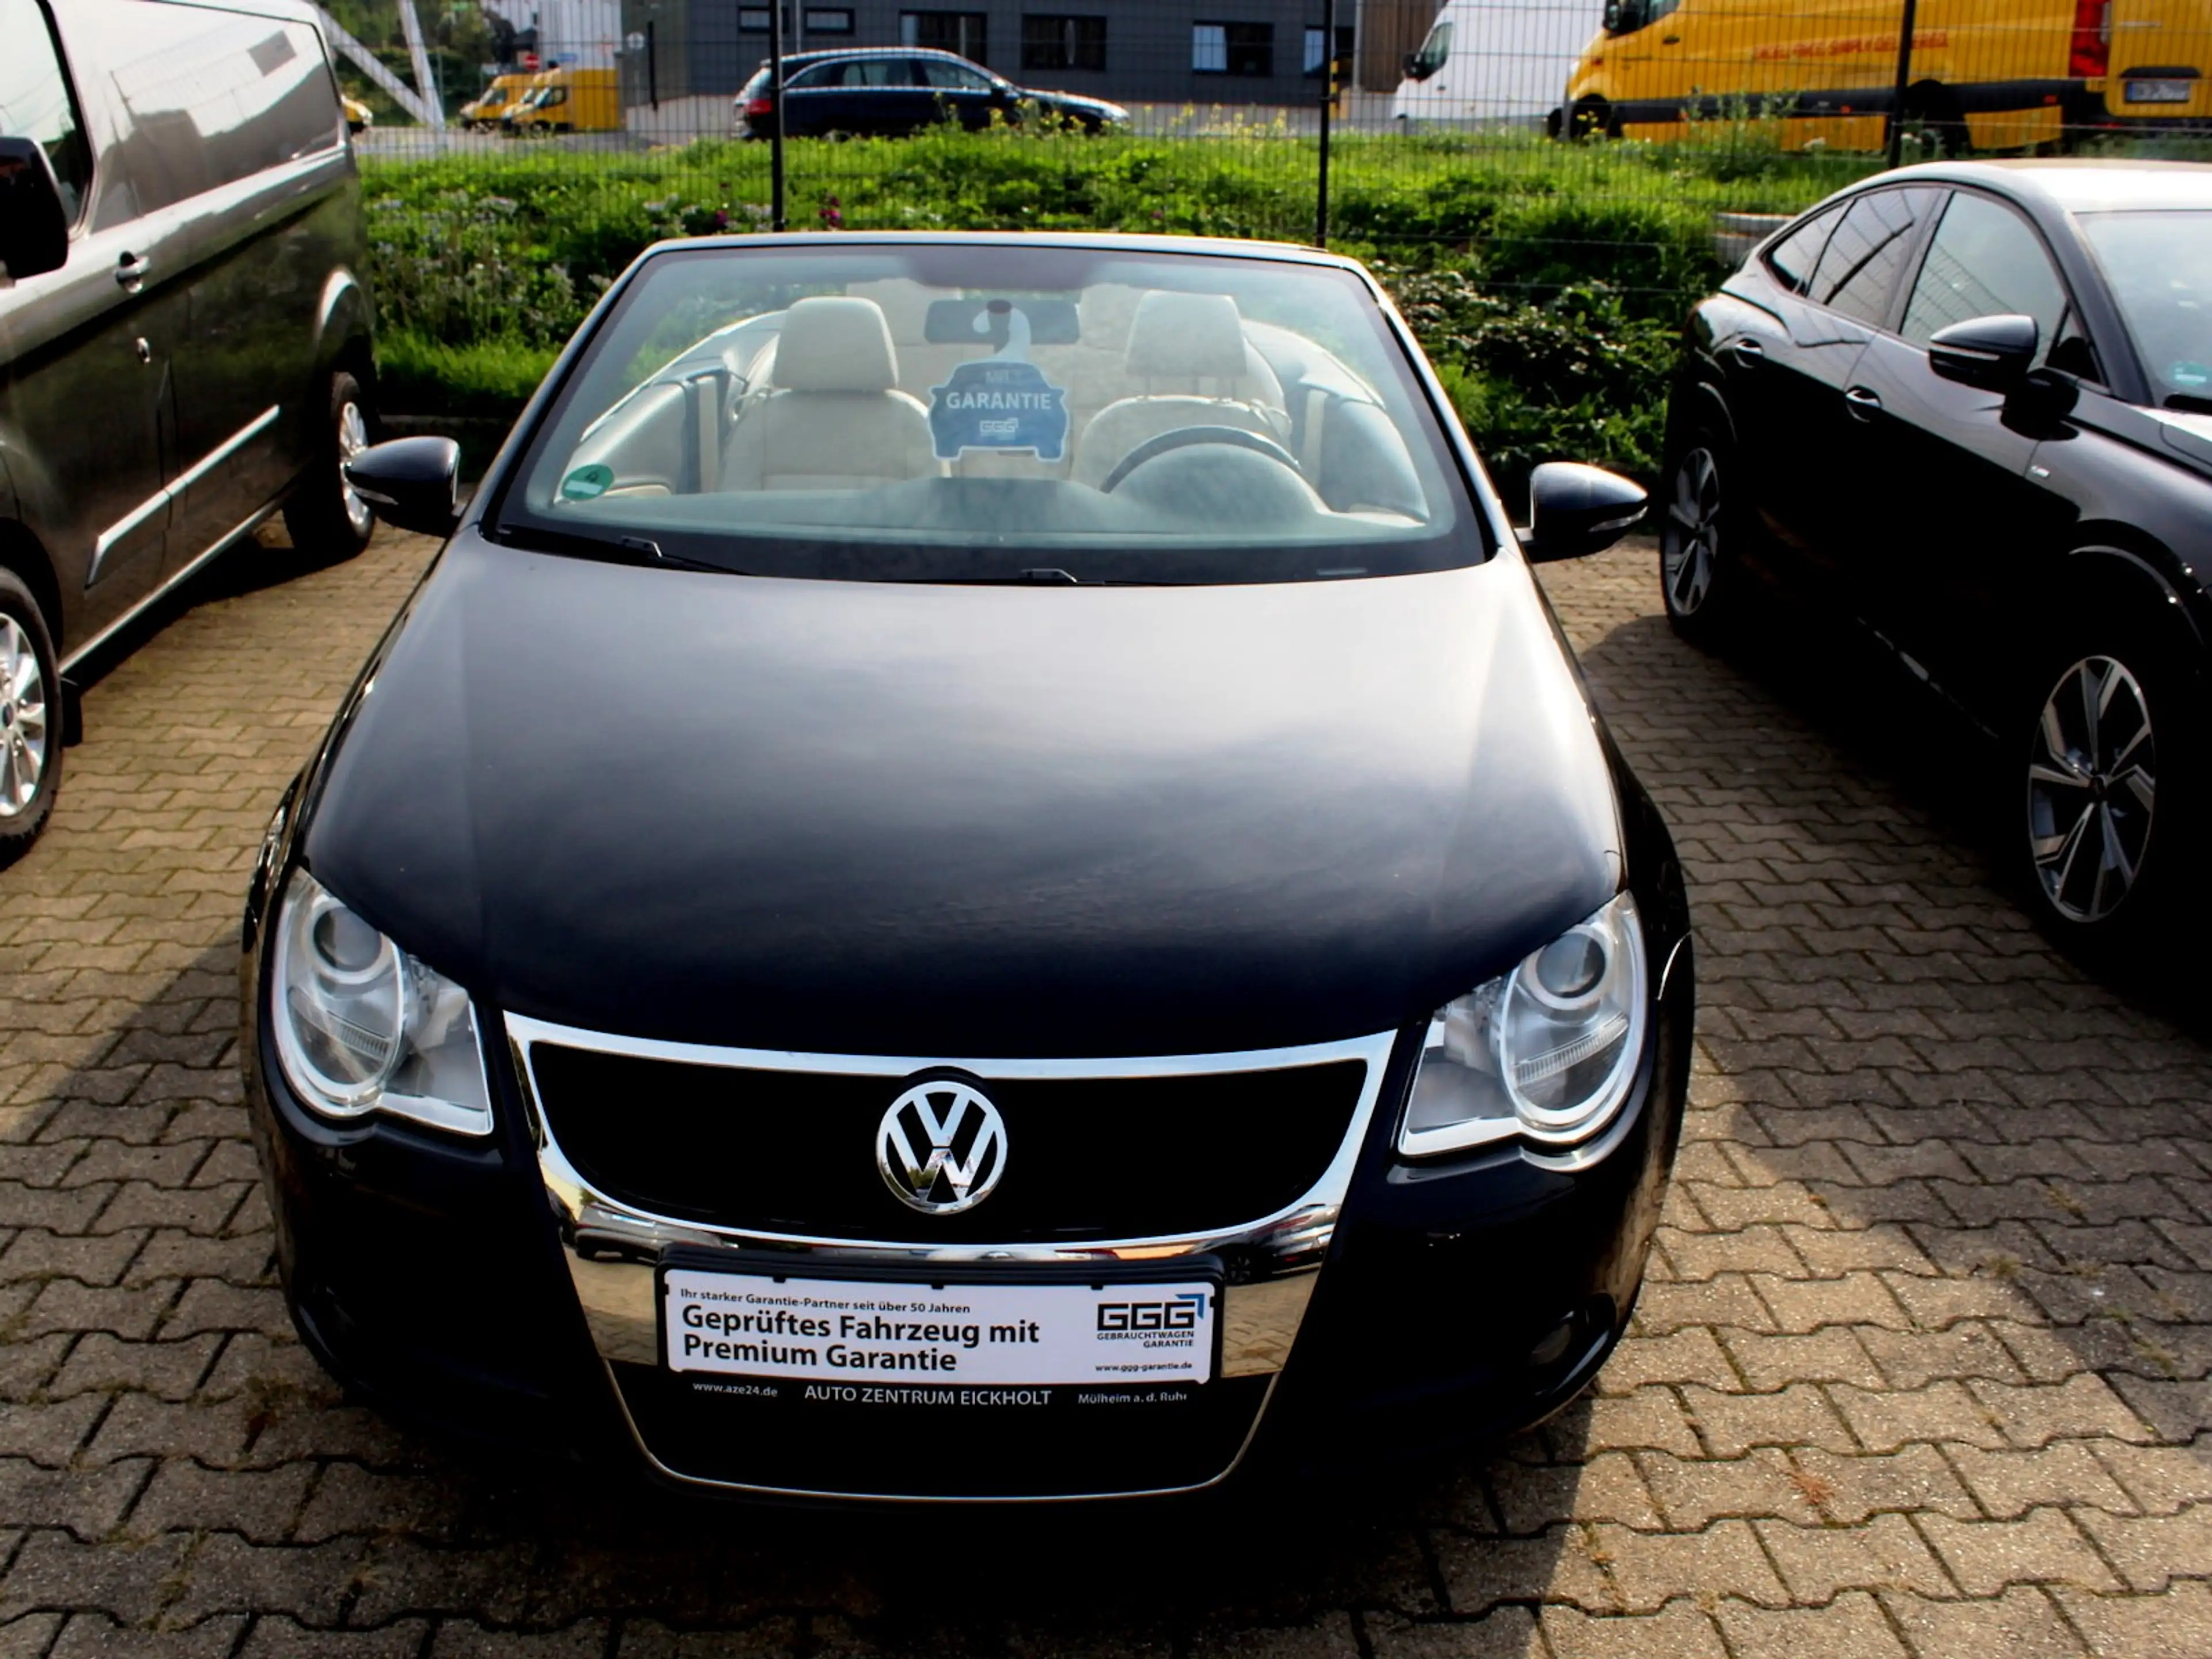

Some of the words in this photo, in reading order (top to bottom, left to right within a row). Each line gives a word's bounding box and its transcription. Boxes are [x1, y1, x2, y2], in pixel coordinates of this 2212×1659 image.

[946, 392, 1051, 410] GARANTIE
[681, 1288, 698, 1298] Ihr
[700, 1291, 742, 1302] starker
[745, 1294, 849, 1309] Garantie-Partner
[853, 1300, 875, 1311] seit
[878, 1301, 907, 1312] über
[910, 1302, 926, 1313] 50
[927, 1303, 971, 1313] Jahren
[1097, 1301, 1195, 1331] GGG
[683, 1304, 831, 1336] Geprüftes
[840, 1316, 980, 1349] Fahrzeug
[990, 1319, 1040, 1343] mit
[1097, 1331, 1195, 1340] GEBRAUCHTWAGEN
[684, 1334, 817, 1366] Premium
[825, 1344, 957, 1371] Garantie
[1143, 1339, 1194, 1349] GARANTIE
[1095, 1361, 1192, 1373] www.ggg-garantie.de
[692, 1382, 778, 1397] www.aze24.de
[804, 1385, 857, 1401] AUTO
[861, 1387, 955, 1405] ZENTRUM
[960, 1389, 1052, 1406] EICKHOLT
[1078, 1392, 1131, 1404] Mülheim
[1160, 1390, 1188, 1402] Ruhr
